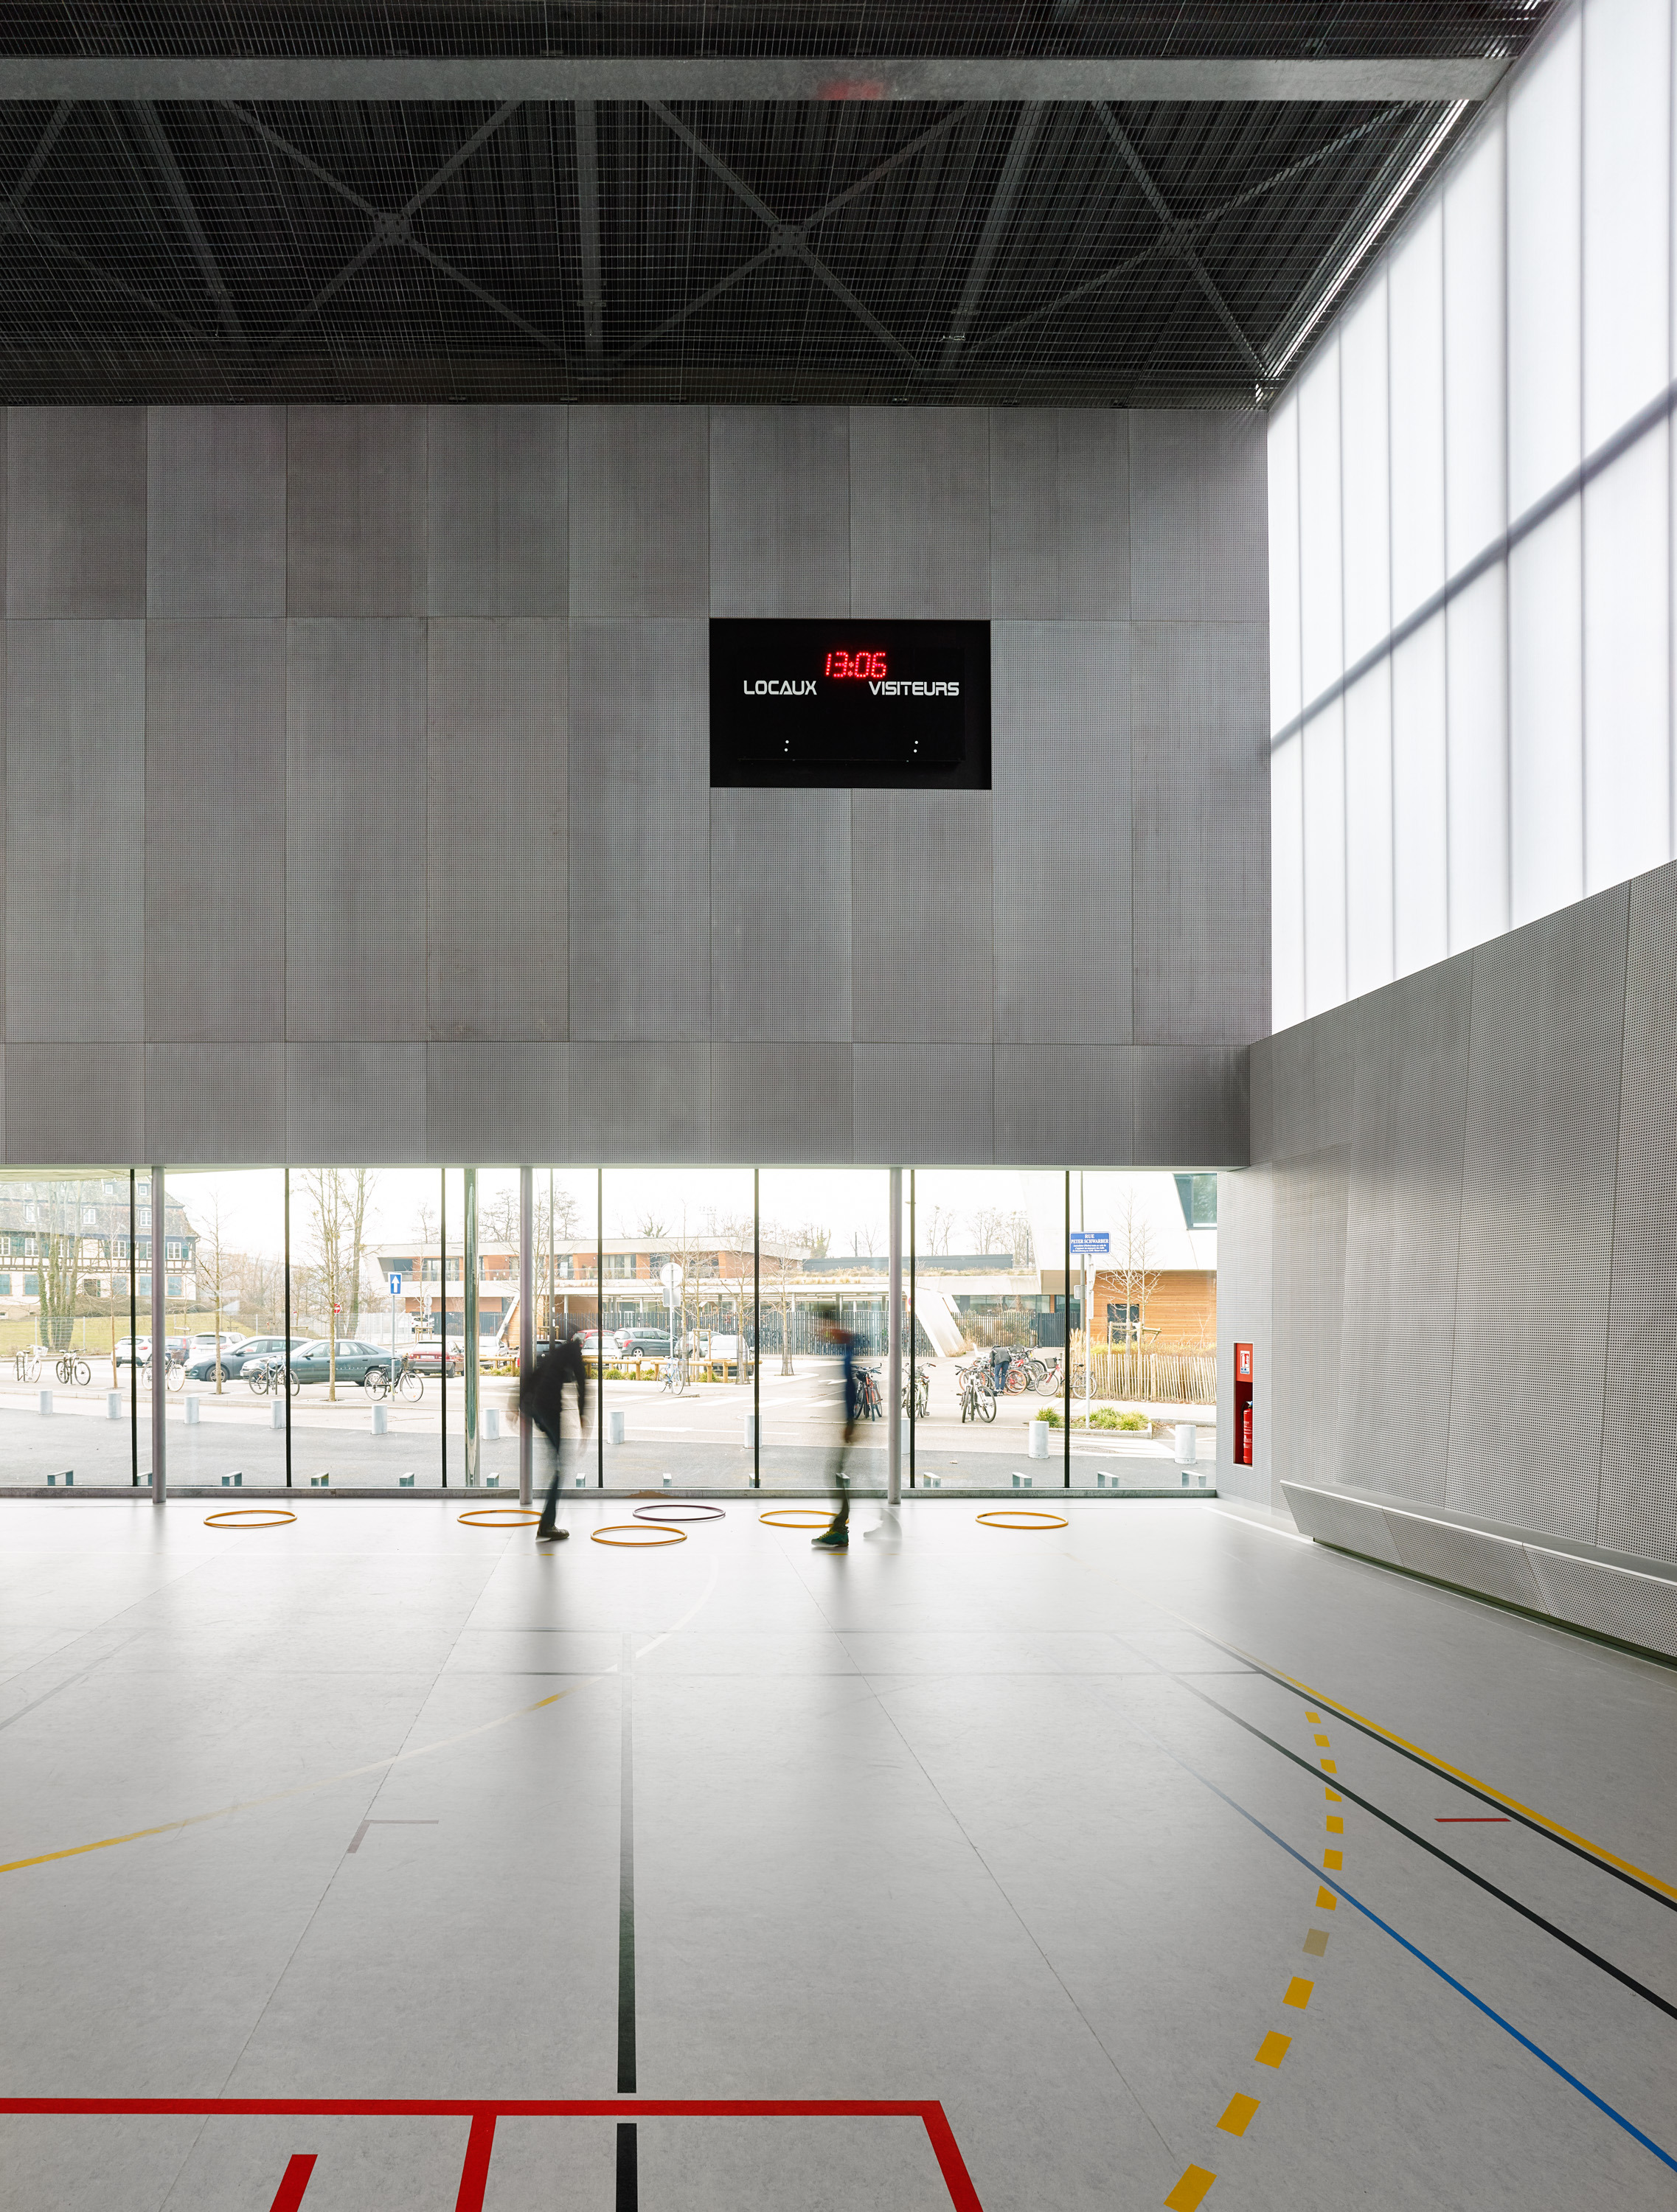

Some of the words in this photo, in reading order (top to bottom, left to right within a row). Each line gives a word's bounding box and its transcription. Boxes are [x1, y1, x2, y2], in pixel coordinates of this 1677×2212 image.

[826, 652, 886, 678] 13:06
[743, 680, 817, 695] LOCAUX
[868, 681, 959, 696] VISITEURS
